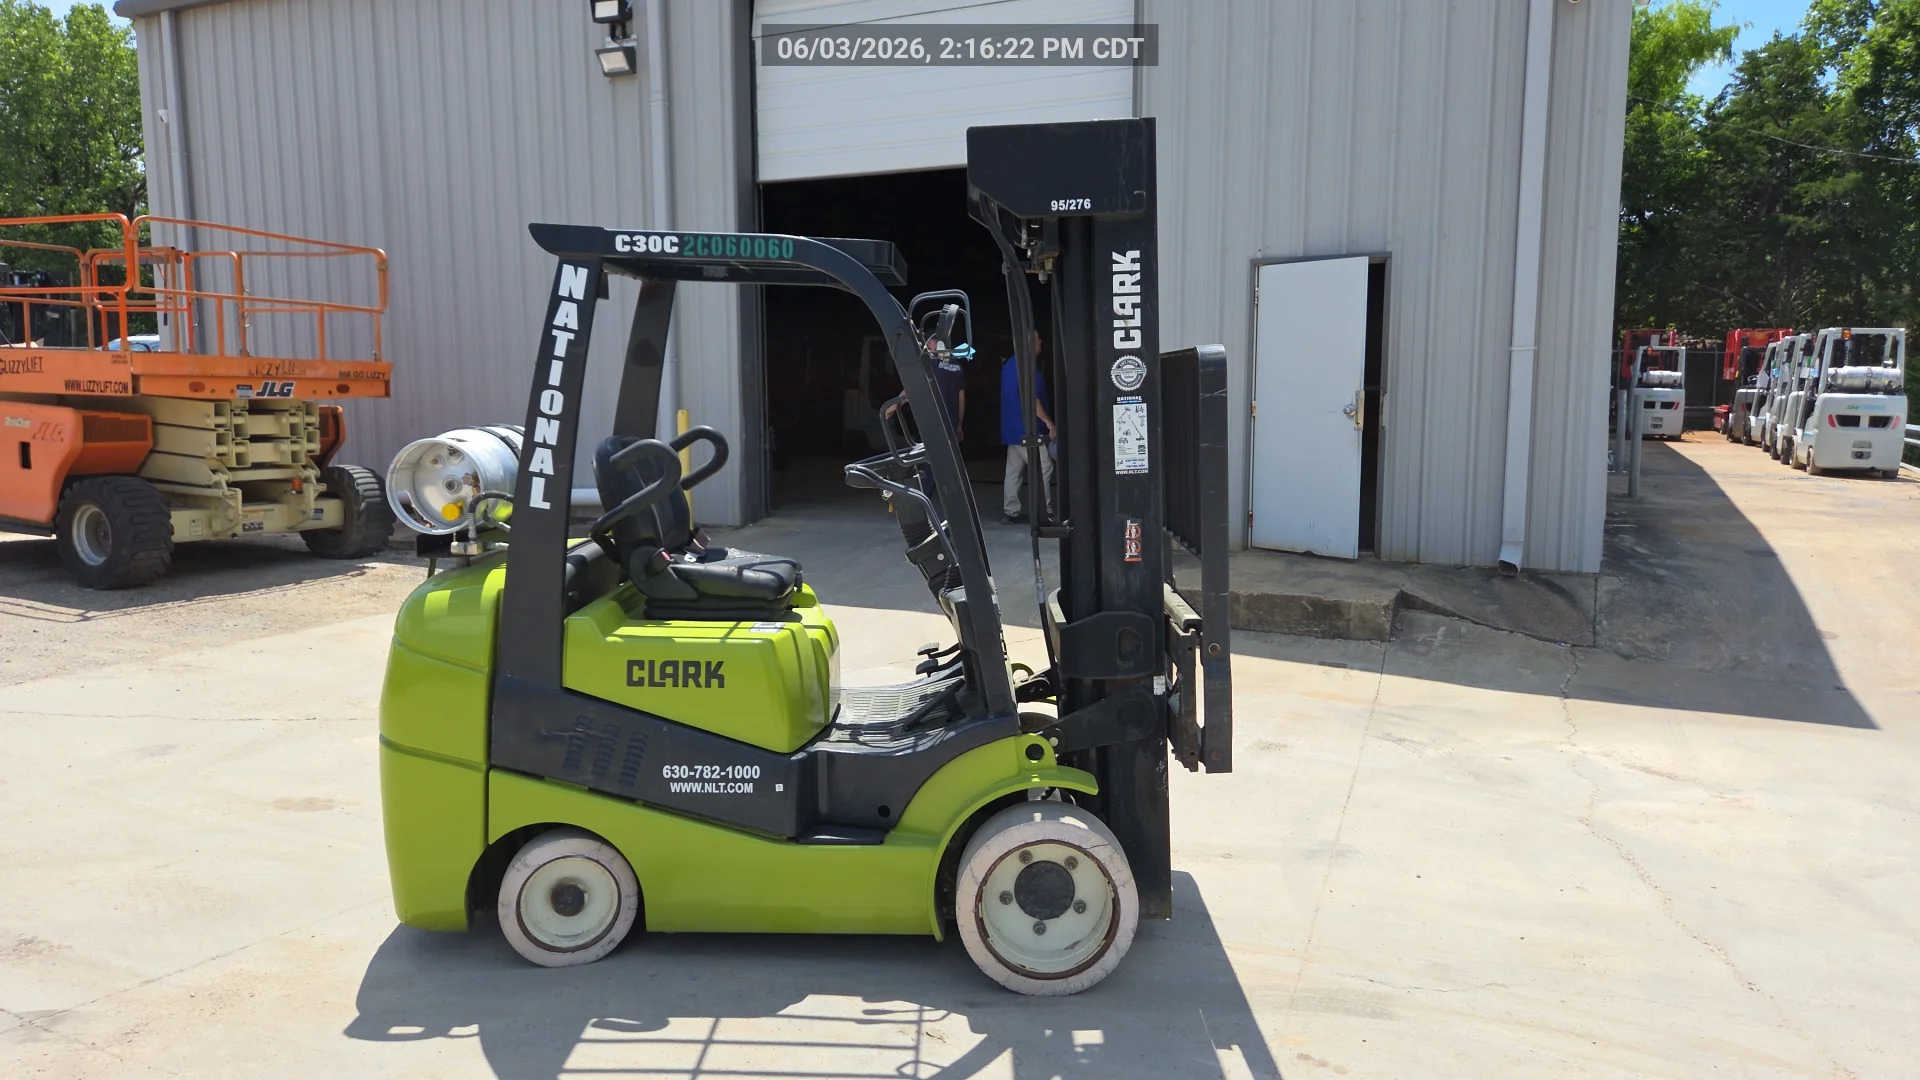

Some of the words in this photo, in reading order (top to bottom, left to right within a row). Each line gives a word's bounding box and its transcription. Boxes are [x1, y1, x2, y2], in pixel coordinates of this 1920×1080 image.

[1050, 198, 1092, 211] 95/276
[615, 234, 679, 253] C30C
[683, 235, 794, 259] 2C060060
[1112, 249, 1142, 350] CLARK
[64, 379, 129, 394] WWW.LIZZYLIFT.COM
[255, 382, 294, 397] JLG
[528, 263, 589, 510] NATIONAL
[626, 660, 725, 688] CLARK
[662, 765, 761, 779] 630-782-1000
[670, 782, 753, 793] WWW.NLT.COM
